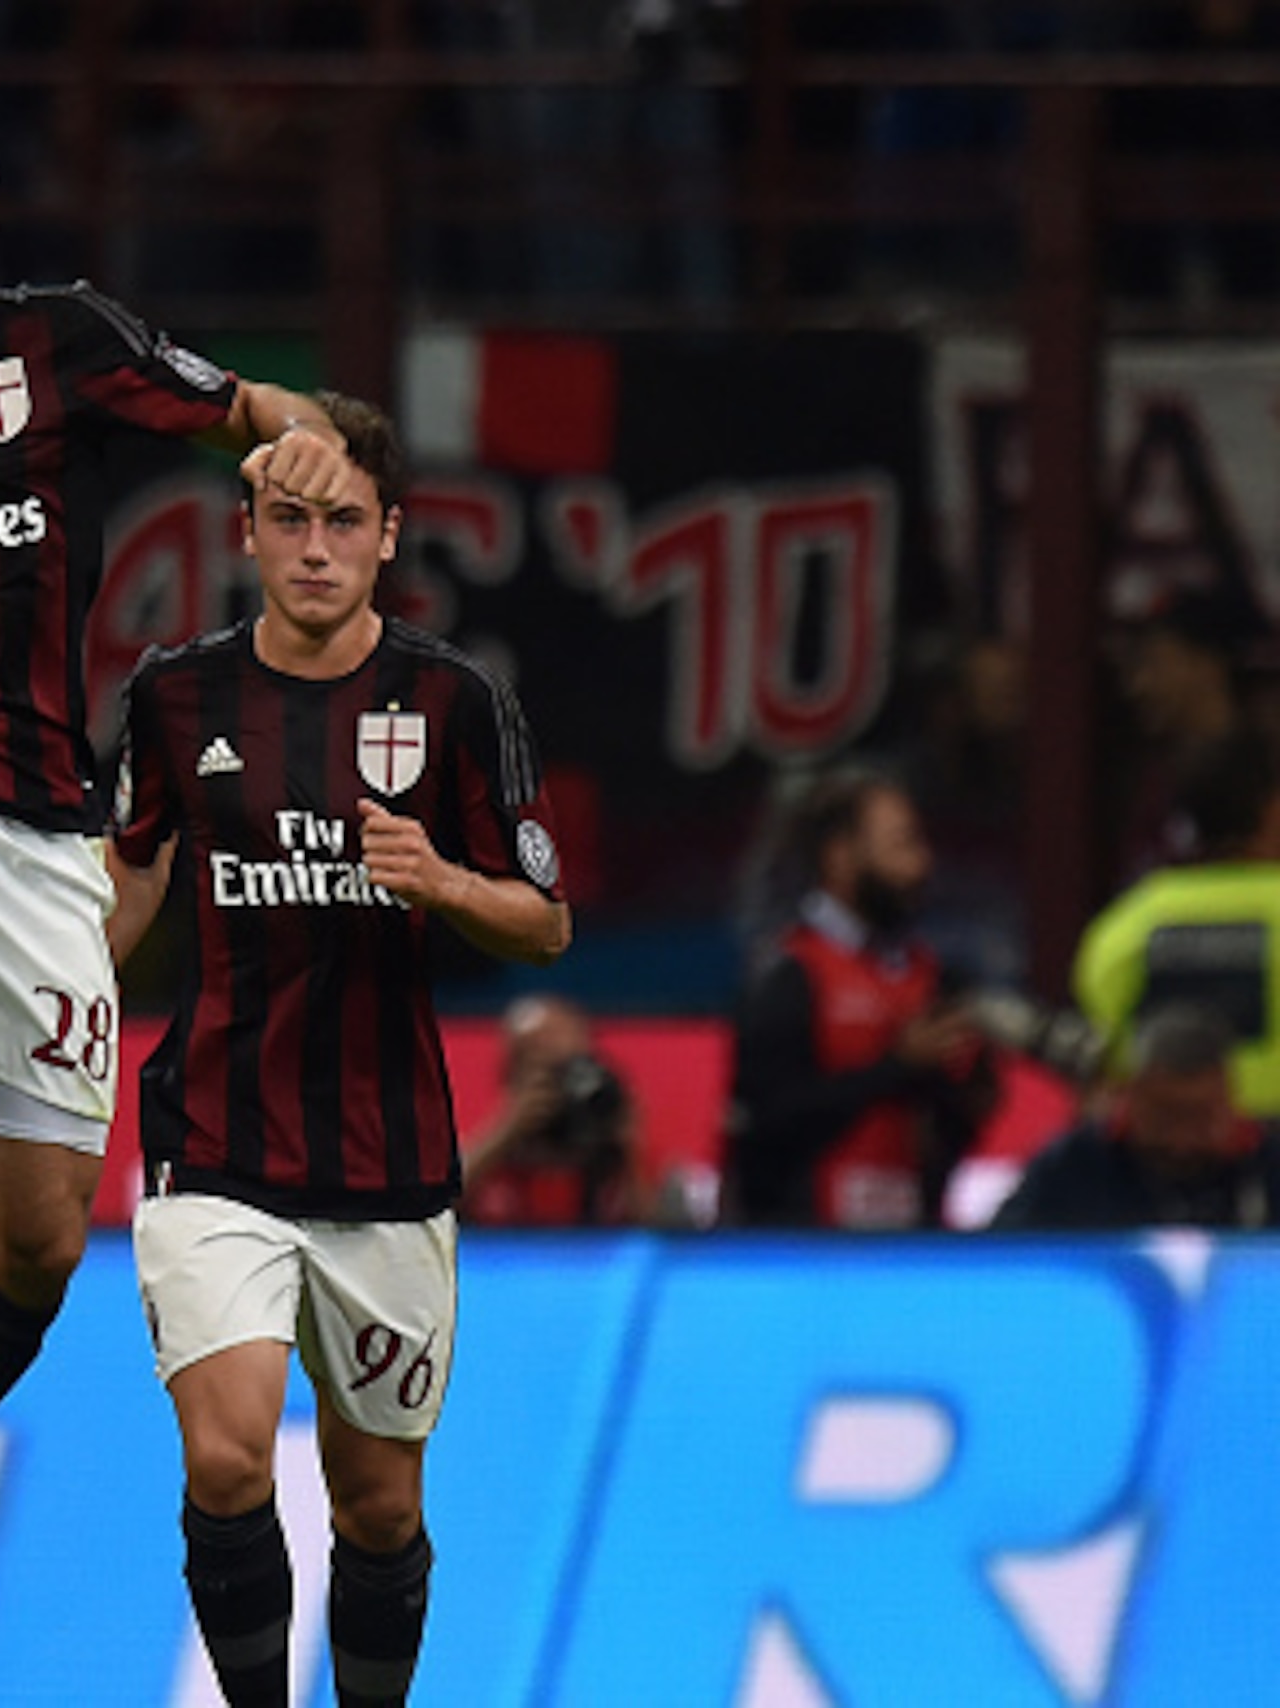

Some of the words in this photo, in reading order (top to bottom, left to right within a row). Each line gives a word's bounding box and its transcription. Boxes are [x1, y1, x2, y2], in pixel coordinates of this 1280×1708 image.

[274, 810, 345, 858] Fly
[209, 849, 413, 910] Emirat
[30, 985, 112, 1081] 28
[349, 1326, 438, 1409] 96
